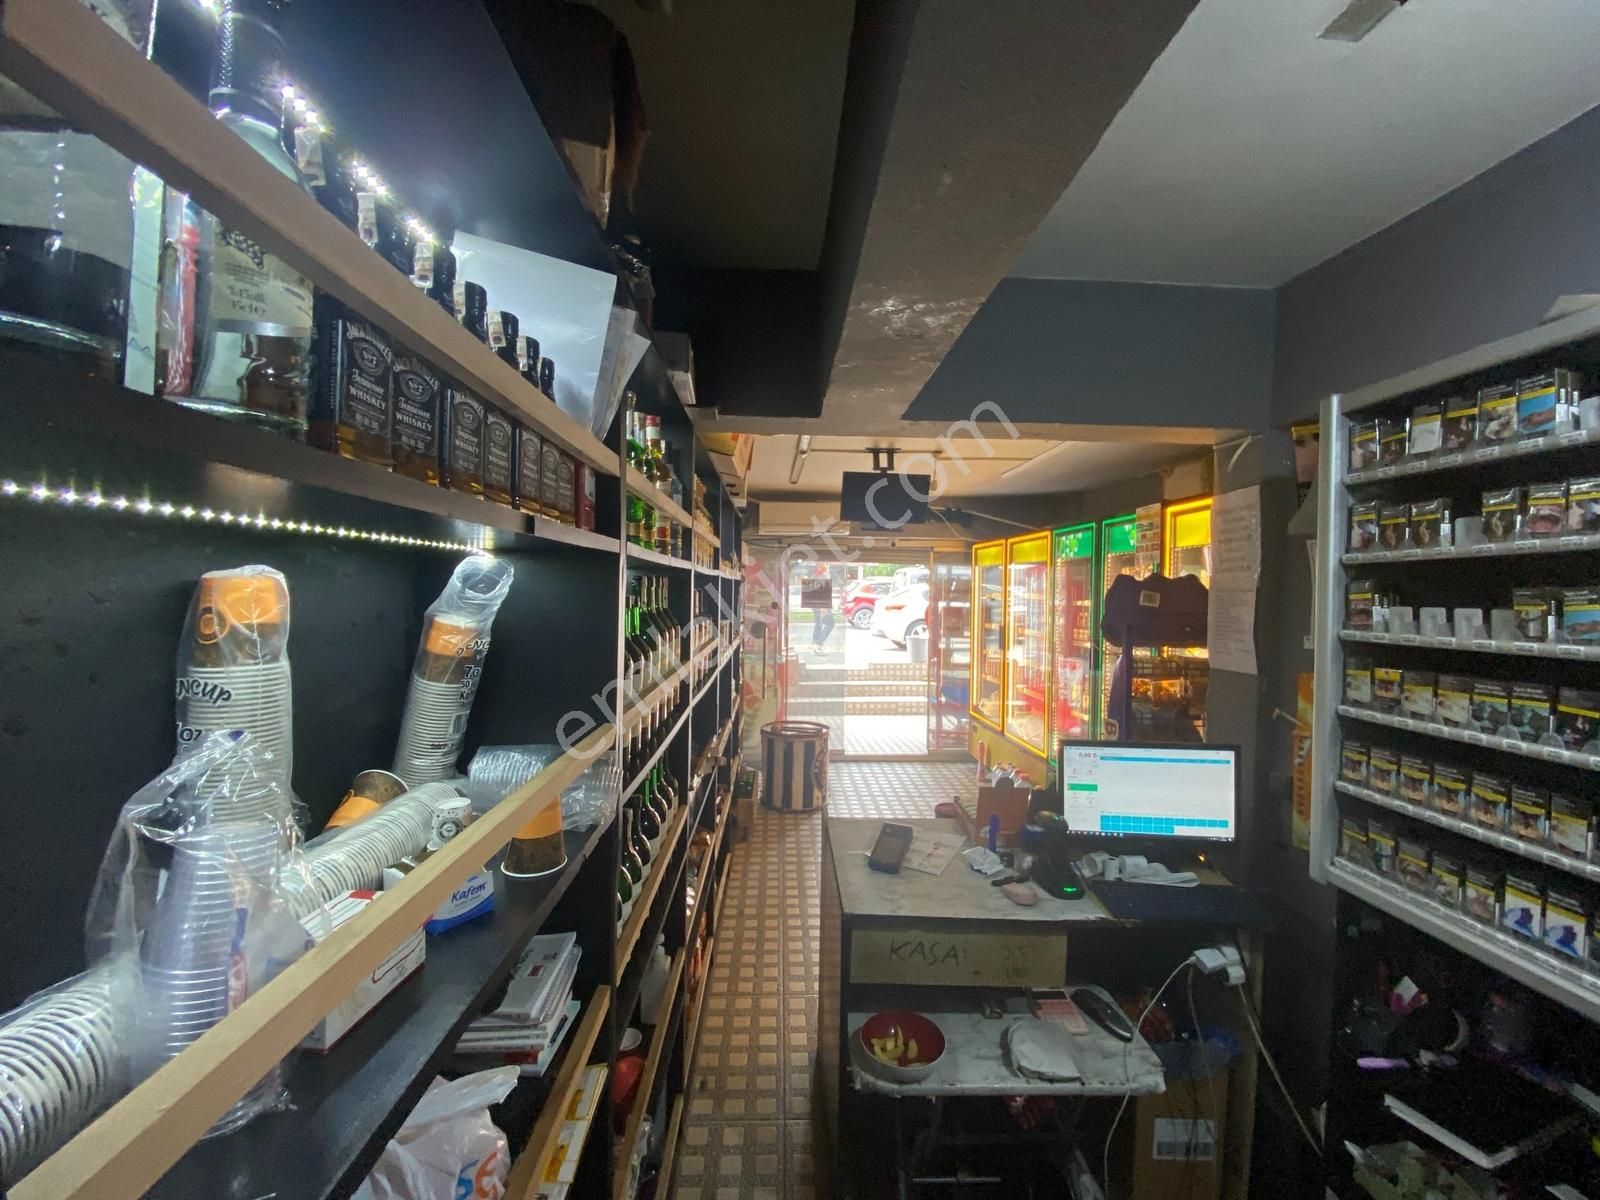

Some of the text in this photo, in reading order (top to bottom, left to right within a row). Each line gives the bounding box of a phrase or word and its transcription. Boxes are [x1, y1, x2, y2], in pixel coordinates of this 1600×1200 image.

[349, 384, 386, 410] WHISKEY
[395, 411, 432, 432] WHISKEY
[451, 881, 487, 903] Kafem
